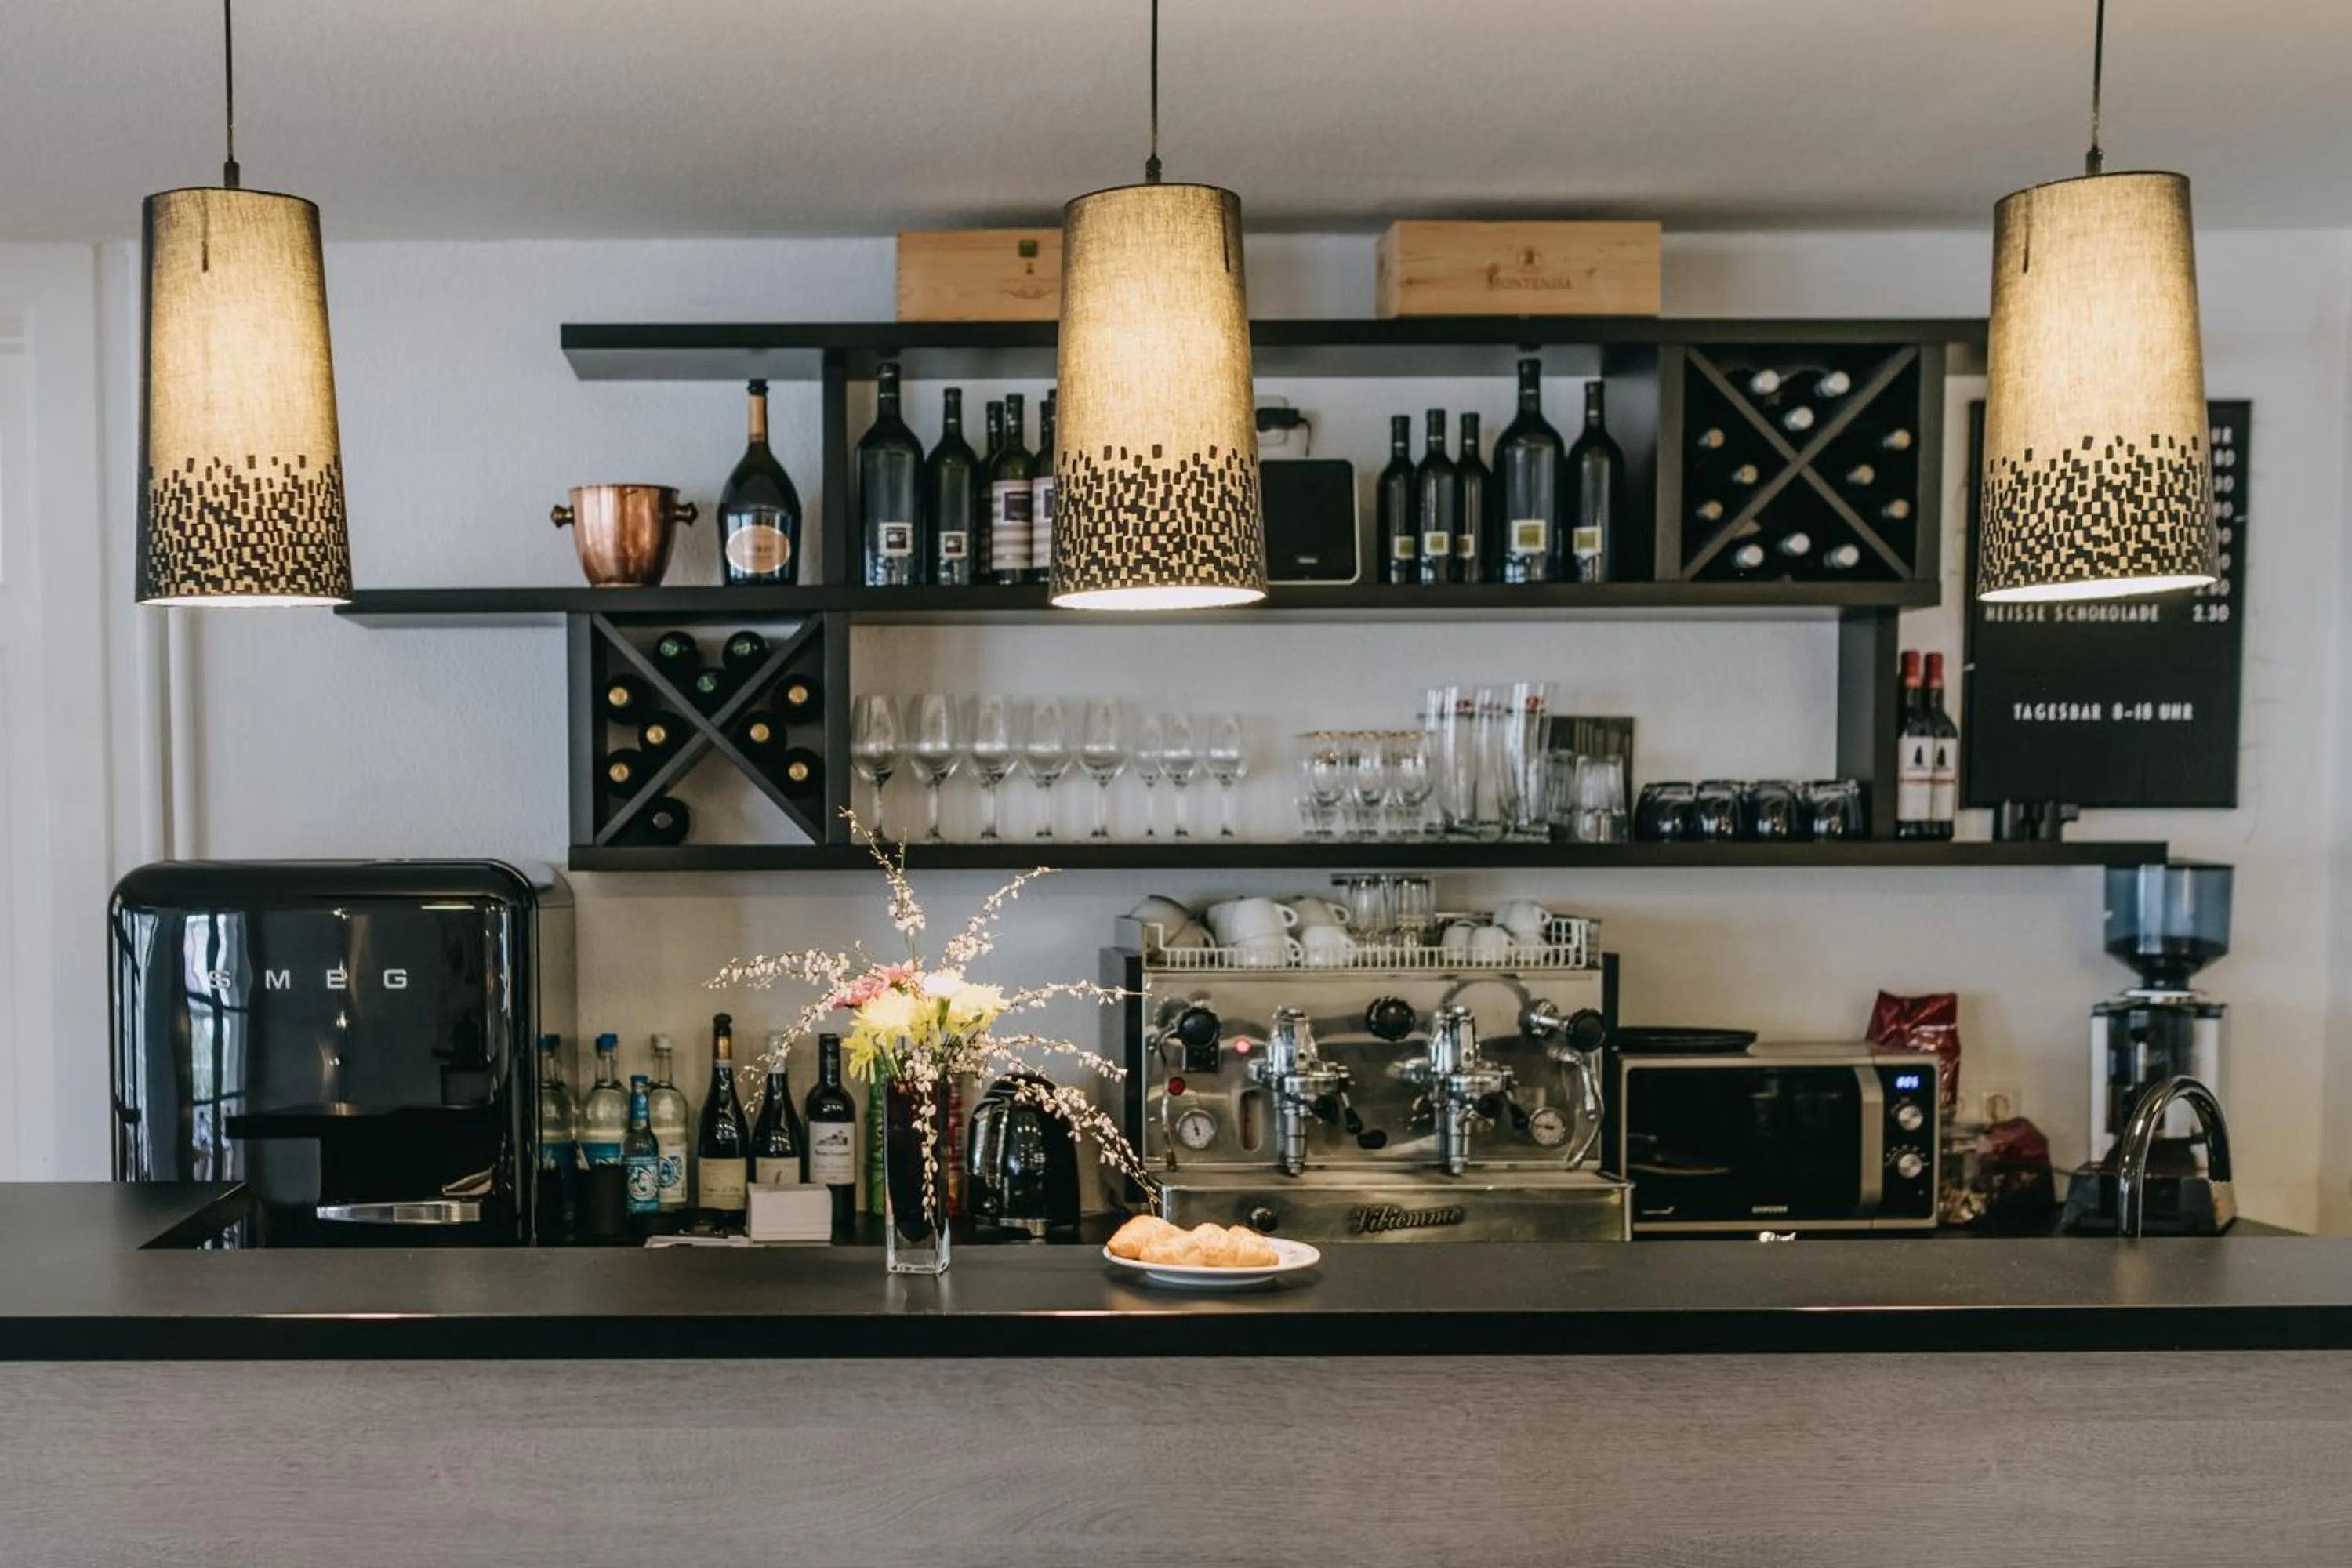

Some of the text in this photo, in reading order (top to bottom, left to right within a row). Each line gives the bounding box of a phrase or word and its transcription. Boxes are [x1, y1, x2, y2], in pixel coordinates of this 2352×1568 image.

[2054, 603, 2158, 622] SCHOKOLADE
[2013, 702, 2102, 720] TAGESBAR
[2158, 702, 2194, 720] UHR
[208, 968, 408, 991] SMEG
